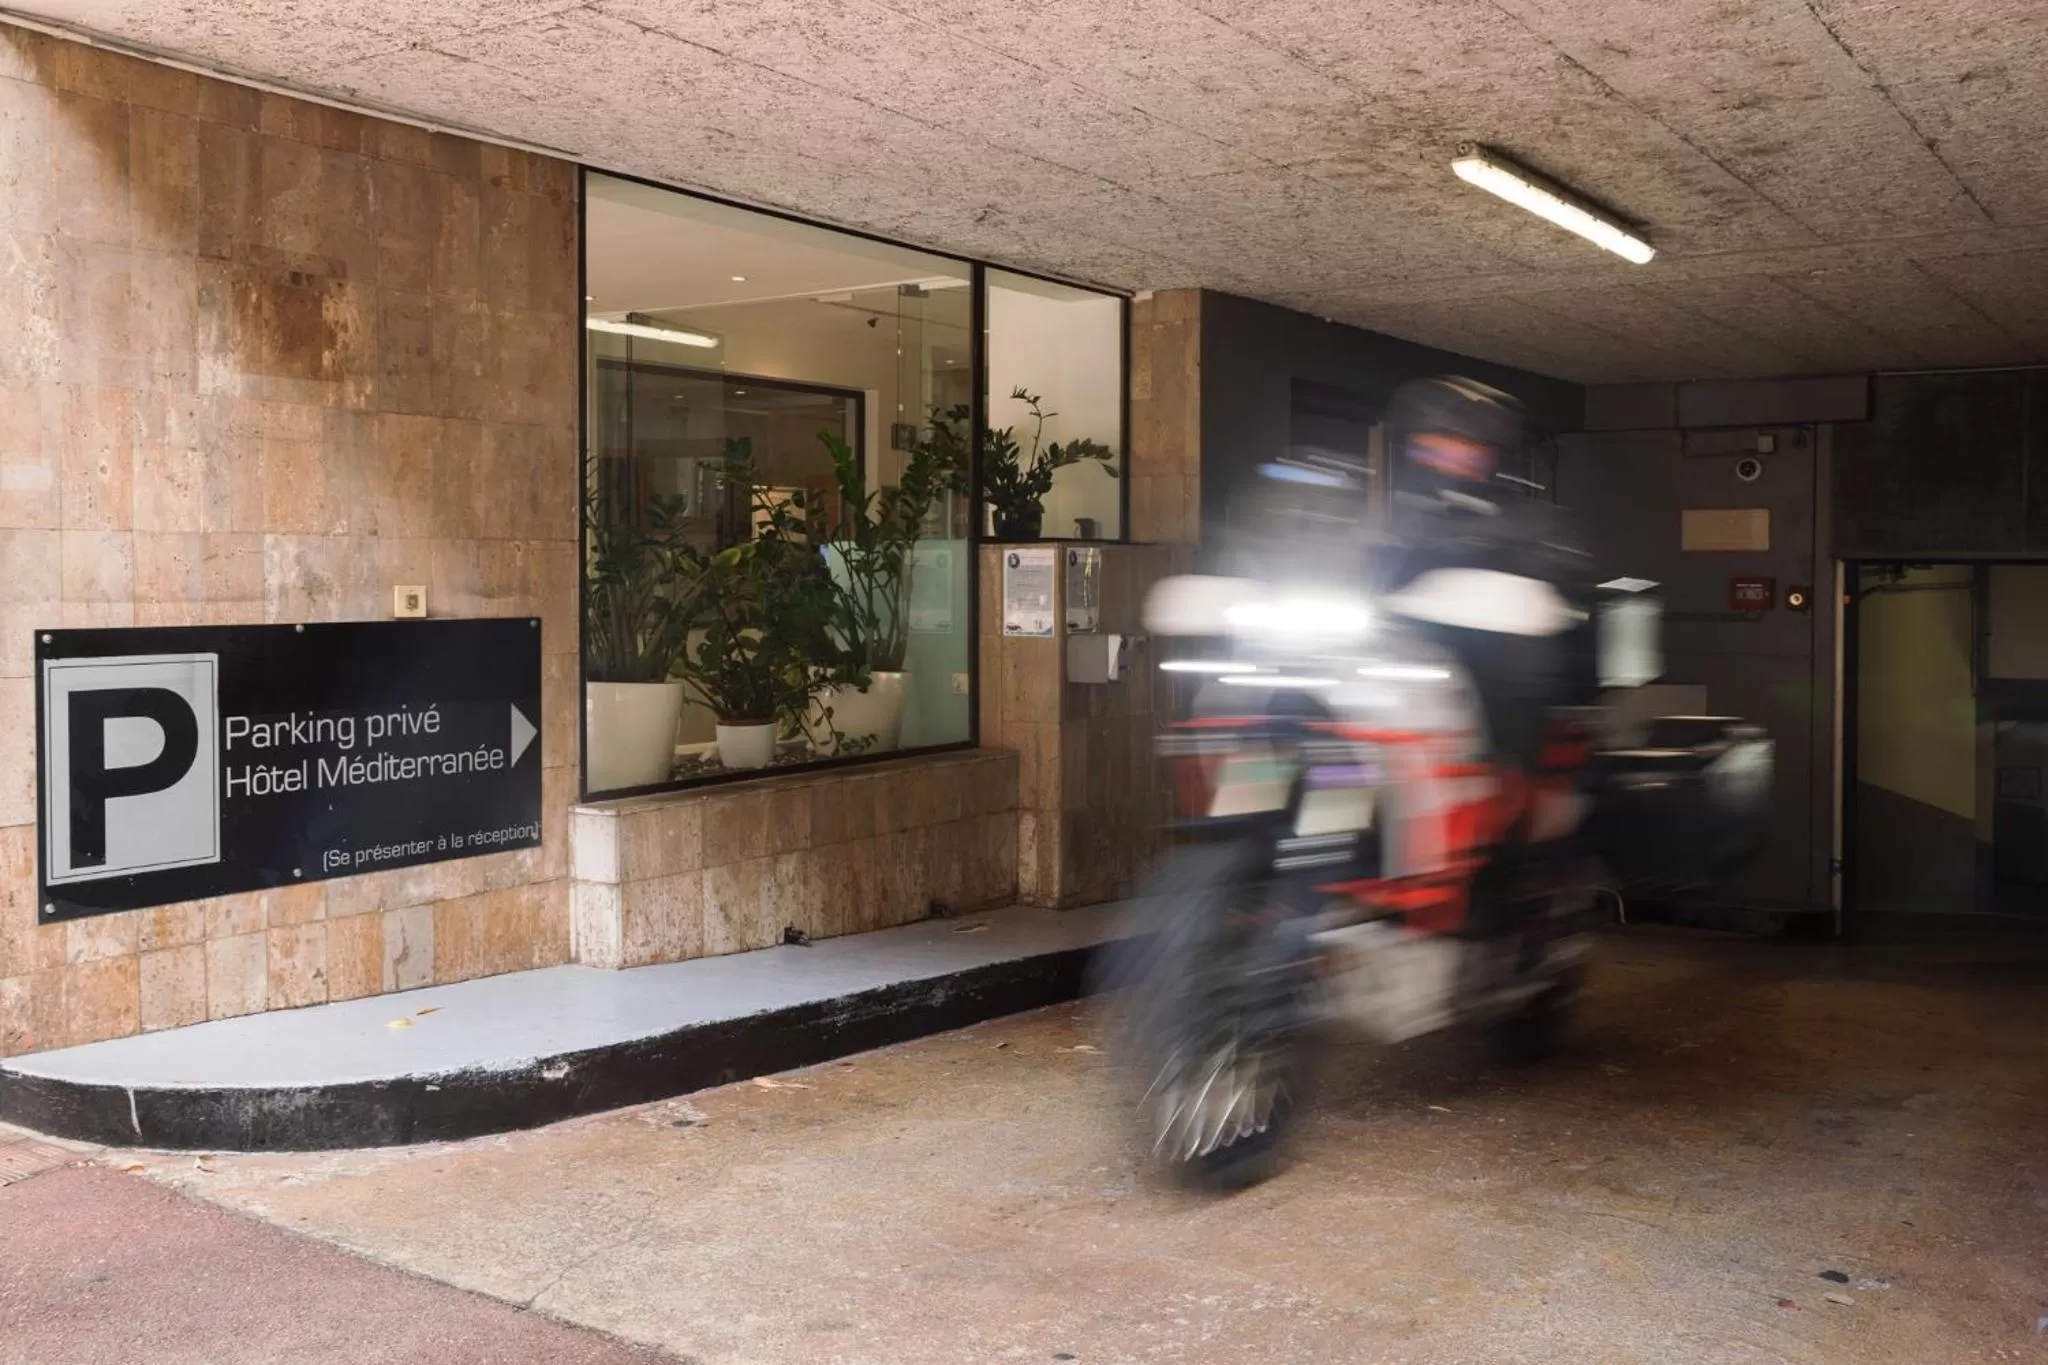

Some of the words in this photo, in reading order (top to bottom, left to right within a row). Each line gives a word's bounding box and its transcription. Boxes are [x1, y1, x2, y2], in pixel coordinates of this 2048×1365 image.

[226, 710, 355, 749] Parking
[365, 703, 440, 747] privé
[68, 687, 199, 870] P
[226, 759, 307, 798] Hôtel
[318, 744, 504, 788] Méditerranée
[323, 849, 351, 873] (Se
[355, 840, 434, 869] présenter
[438, 835, 447, 850] à
[451, 833, 464, 849] la
[467, 821, 539, 845] réception)
